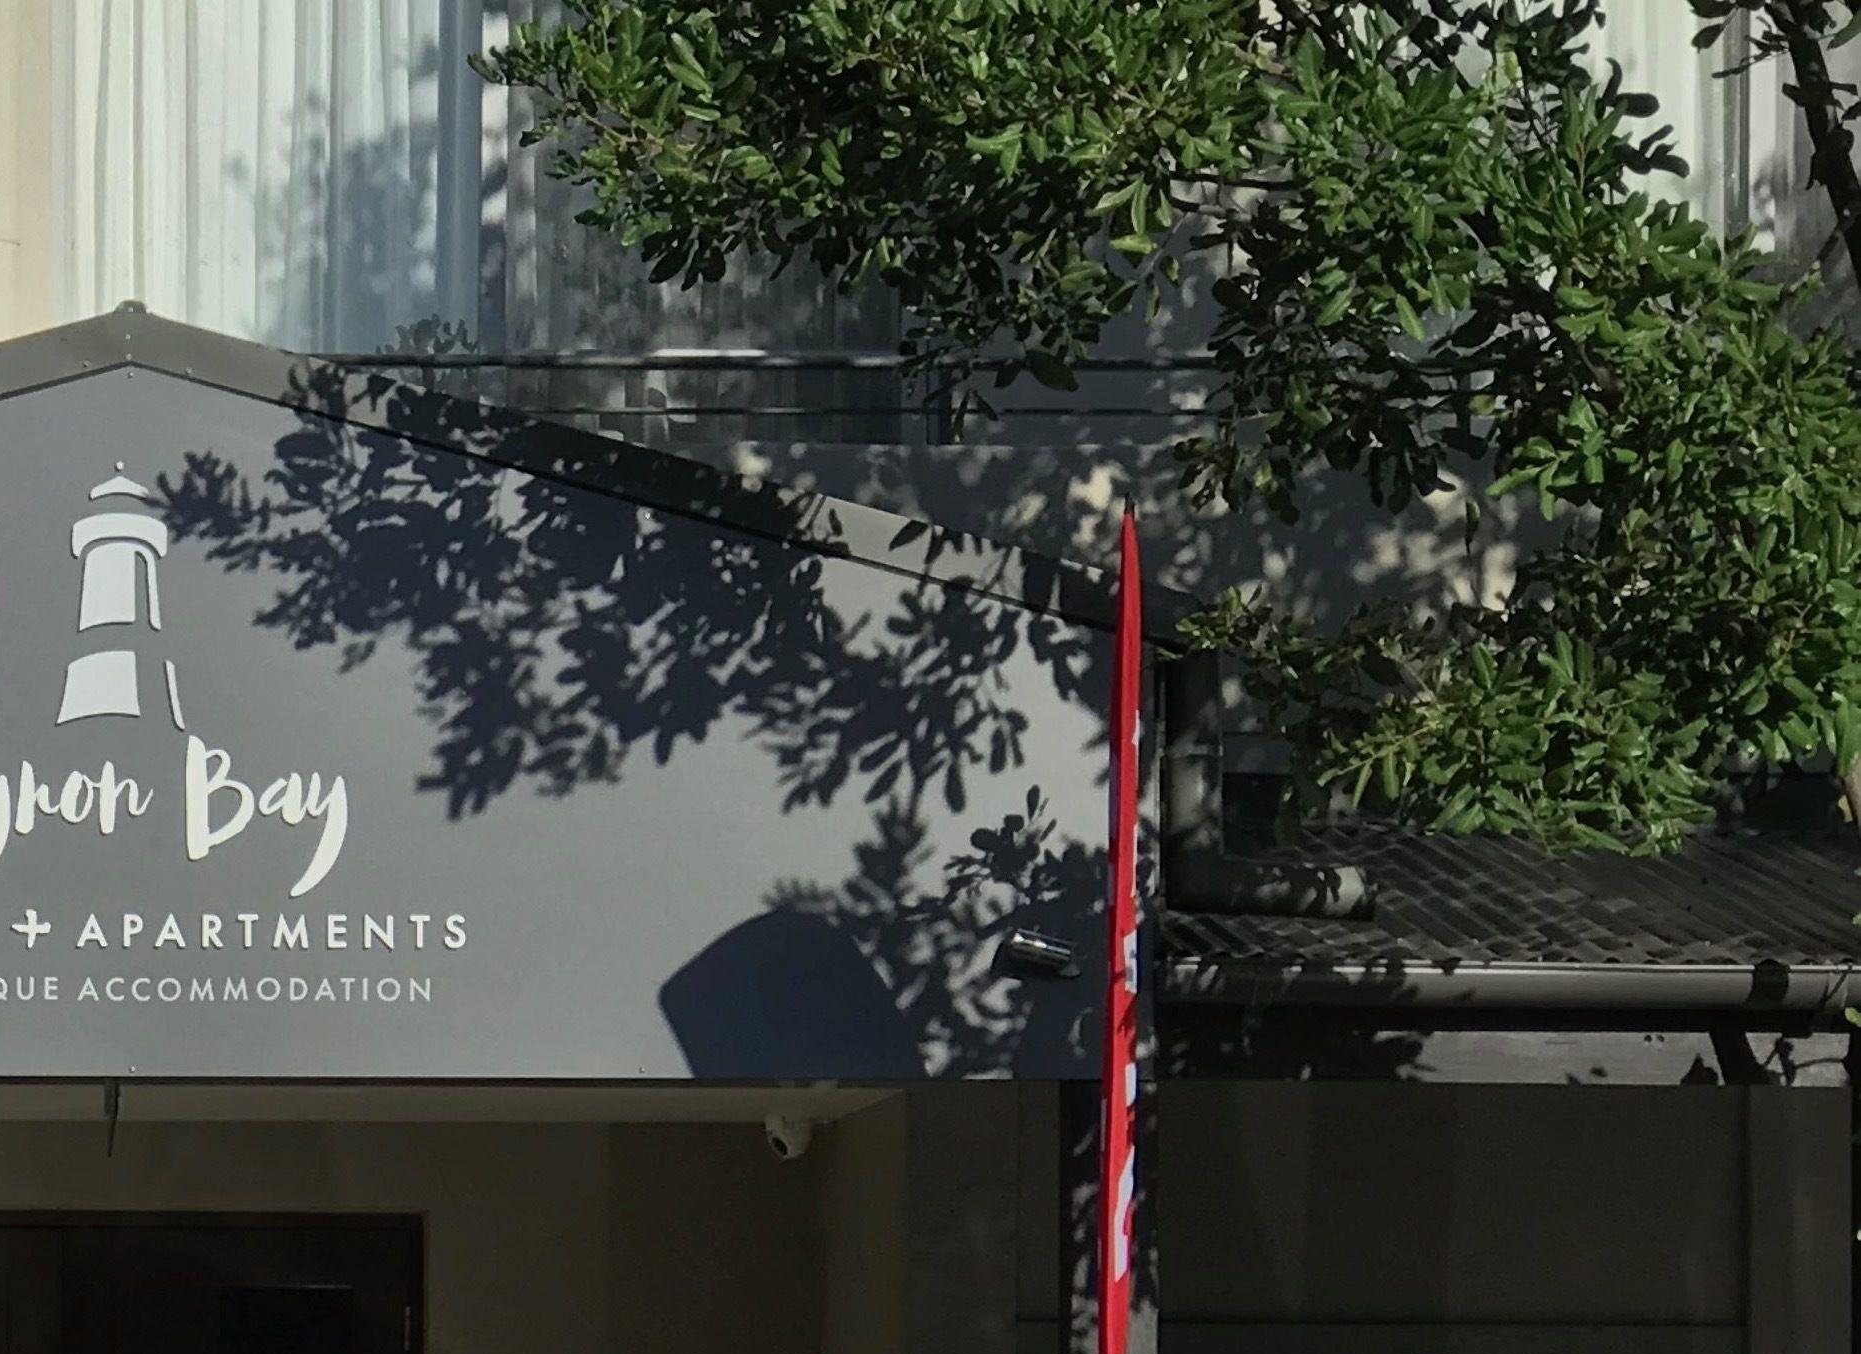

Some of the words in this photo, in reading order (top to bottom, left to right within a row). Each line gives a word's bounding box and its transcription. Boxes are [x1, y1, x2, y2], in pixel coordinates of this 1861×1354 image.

[186, 735, 347, 896] Bay
[77, 914, 466, 949] APARTMENTS
[78, 977, 430, 1002] ACCOMMODATION
